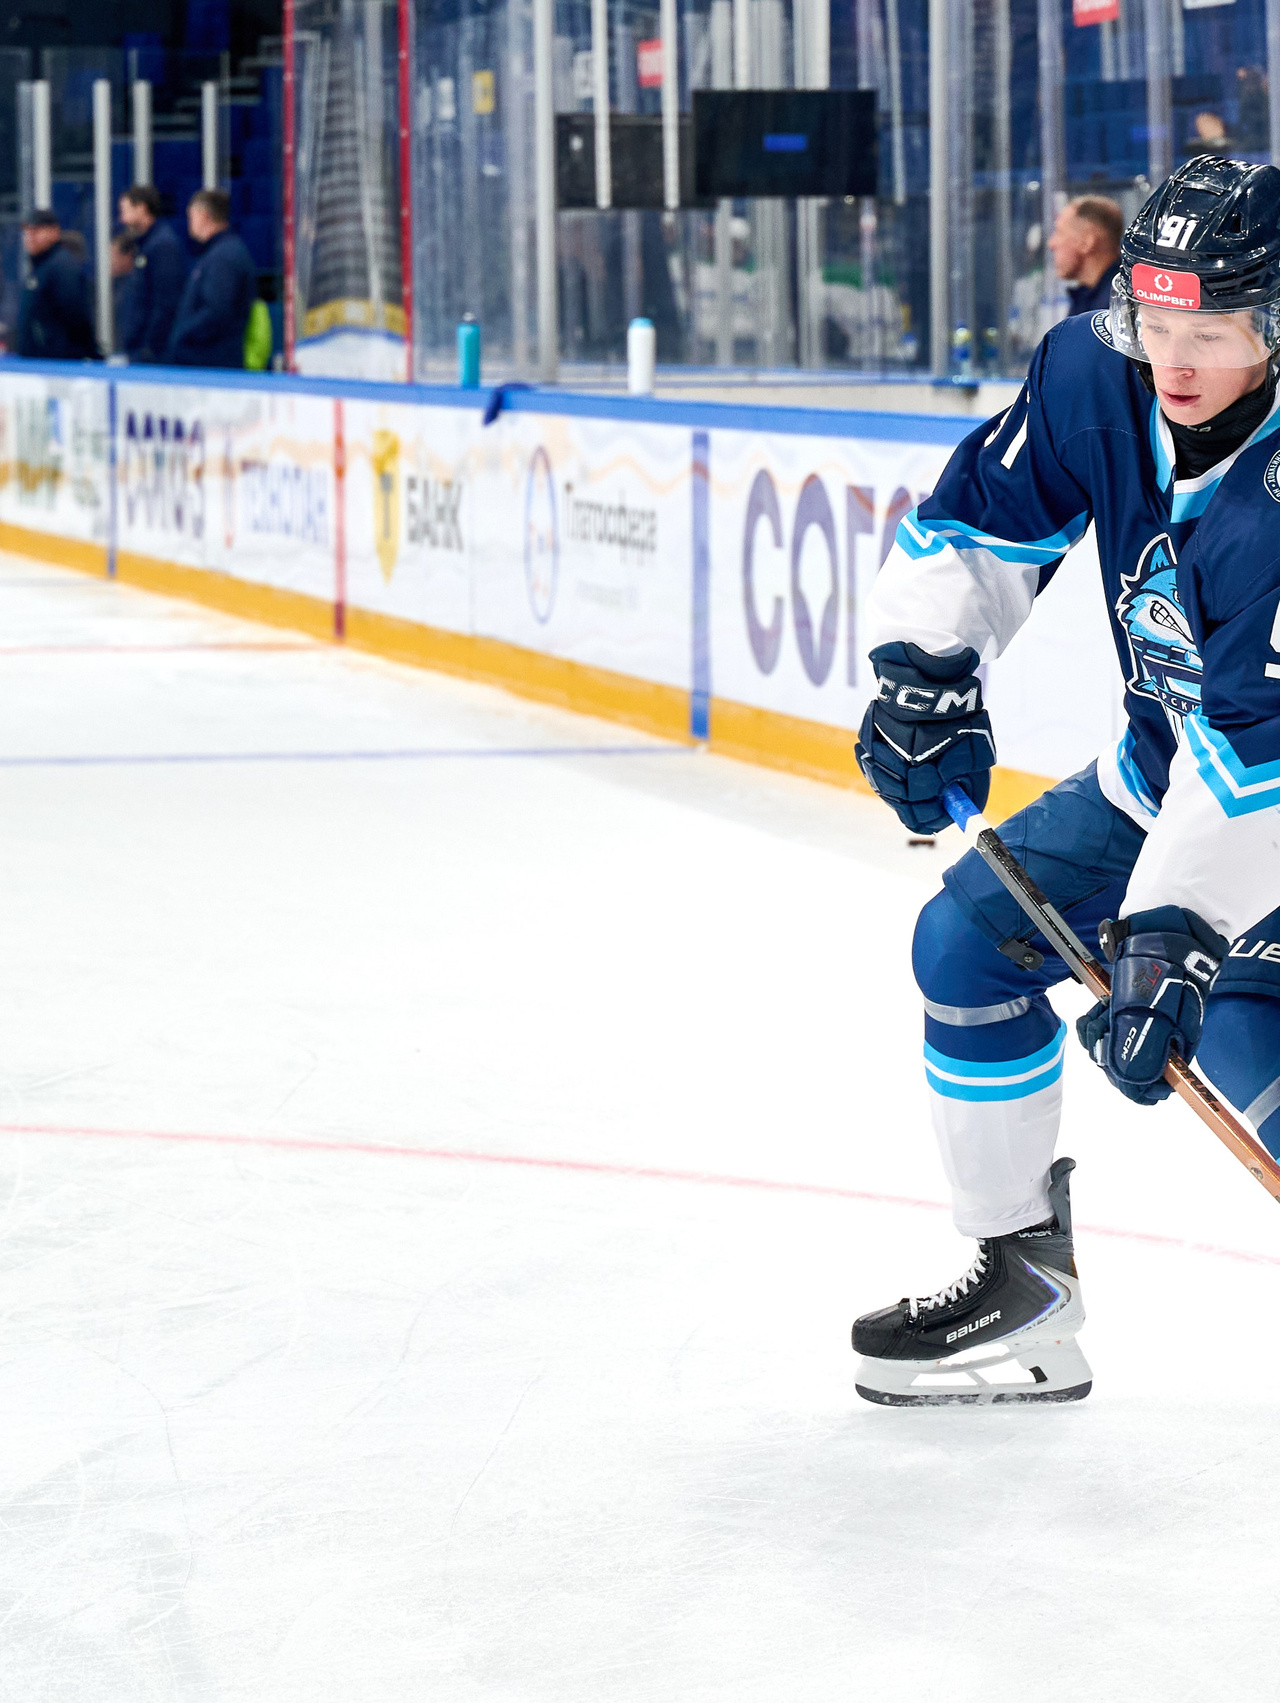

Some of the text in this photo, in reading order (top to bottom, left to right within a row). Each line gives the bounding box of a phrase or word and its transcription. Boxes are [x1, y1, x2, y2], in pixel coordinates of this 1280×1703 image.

[1157, 215, 1199, 250] 91
[1136, 289, 1195, 307] OLIMPBET
[877, 675, 980, 714] CCM
[946, 1309, 1001, 1344] BAUER
